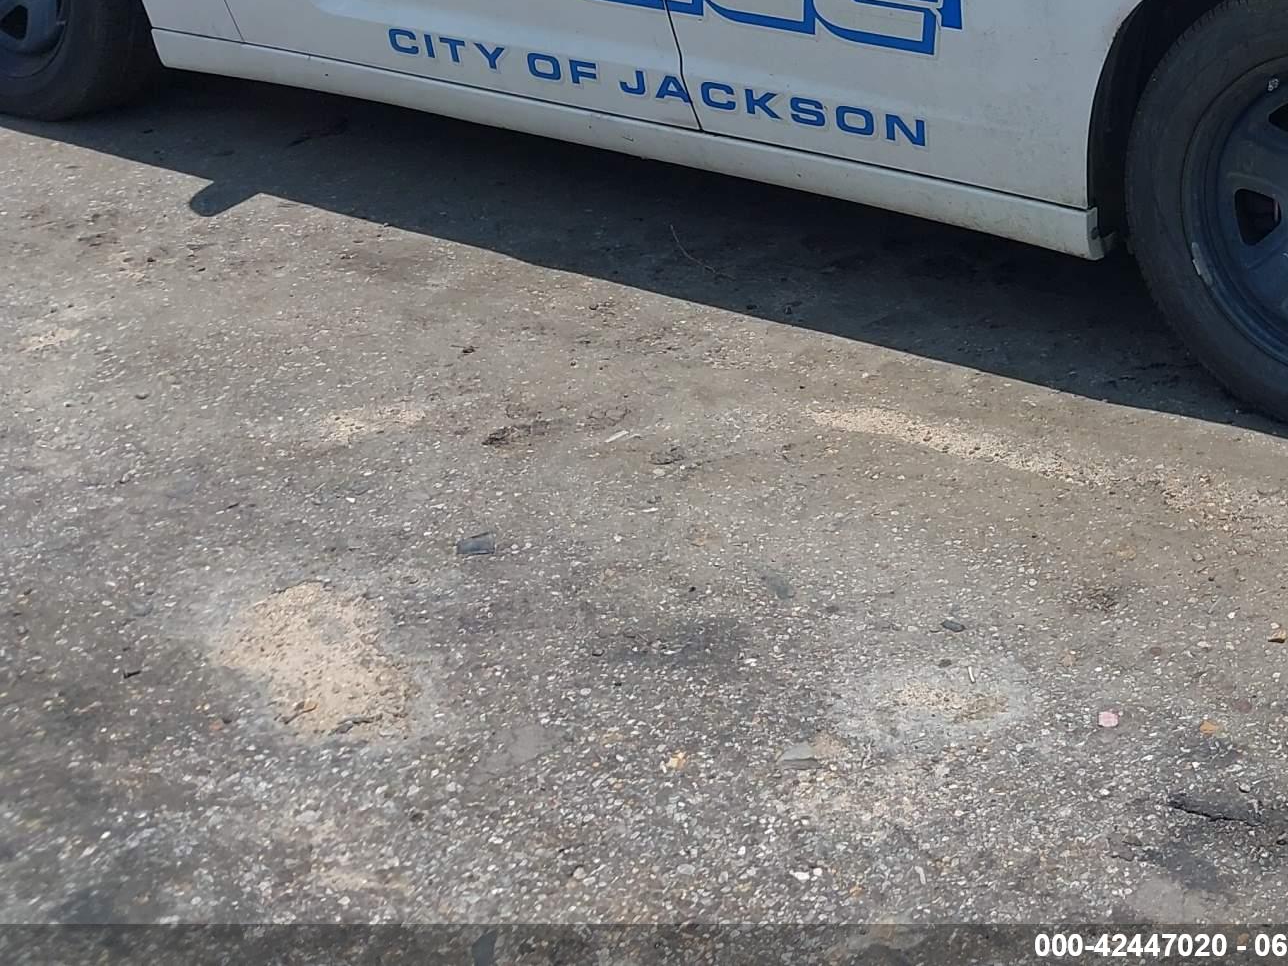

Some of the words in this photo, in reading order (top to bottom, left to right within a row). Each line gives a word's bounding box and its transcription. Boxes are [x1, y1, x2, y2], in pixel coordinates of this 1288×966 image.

[388, 28, 505, 70] CITY
[526, 52, 597, 84] OF
[619, 70, 926, 147] JACKSON
